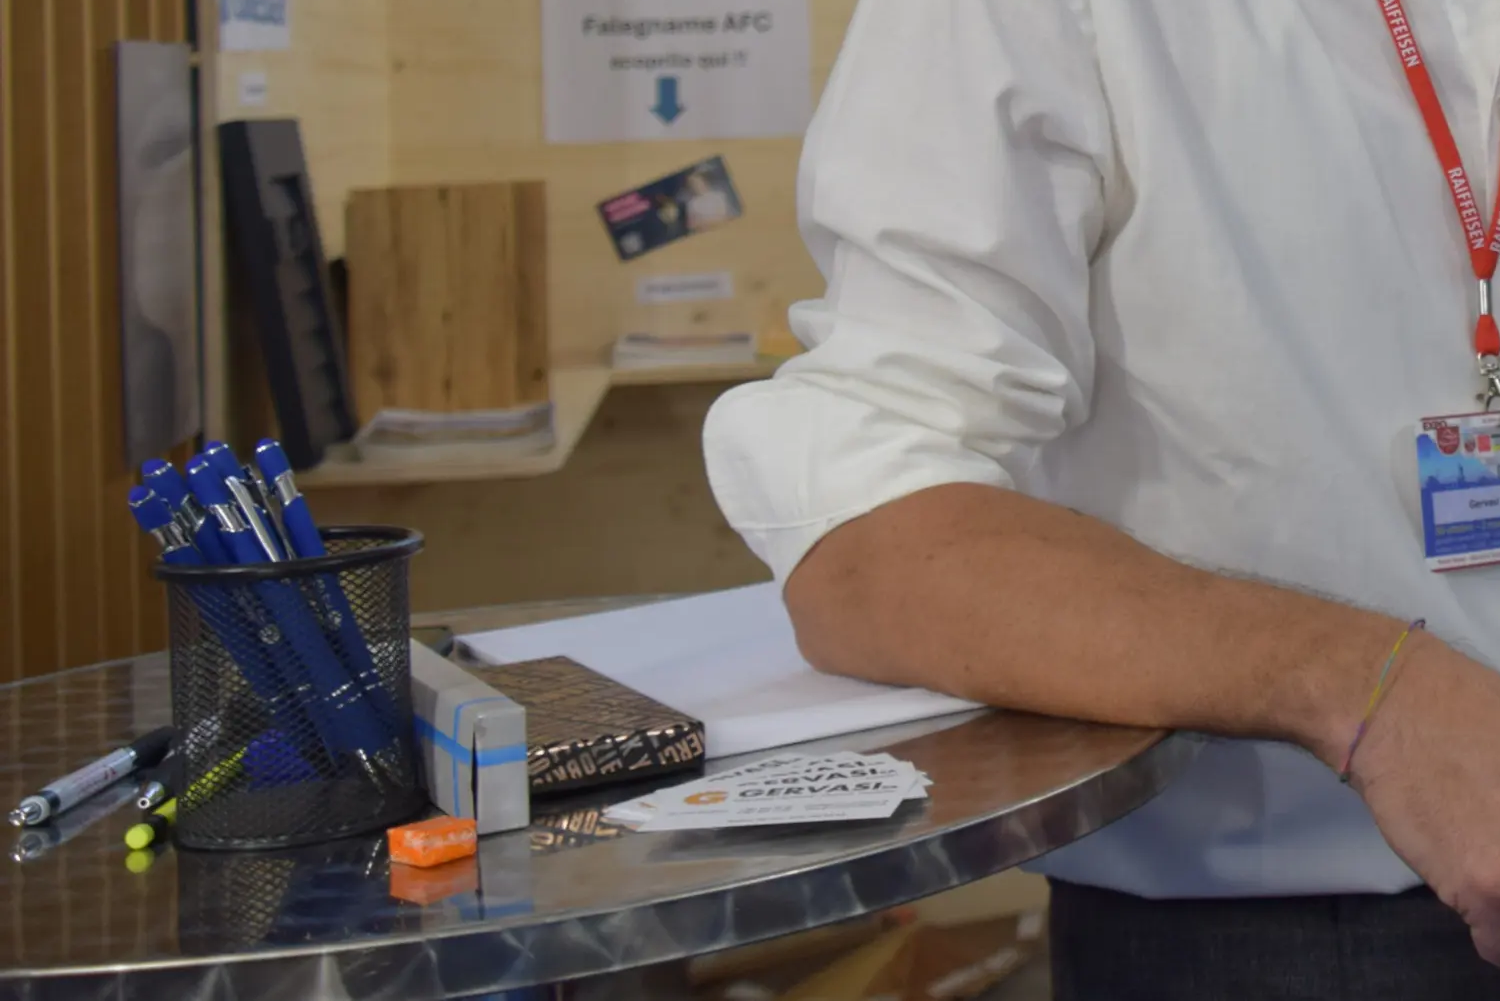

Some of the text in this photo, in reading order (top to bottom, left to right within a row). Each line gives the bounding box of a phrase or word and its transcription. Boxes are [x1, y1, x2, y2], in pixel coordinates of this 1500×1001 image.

[581, 11, 774, 40] Falegname AFC
[1447, 166, 1485, 250] RAIFFEISEN
[1468, 497, 1500, 510] Gervasi
[738, 782, 883, 798] GERVASI
